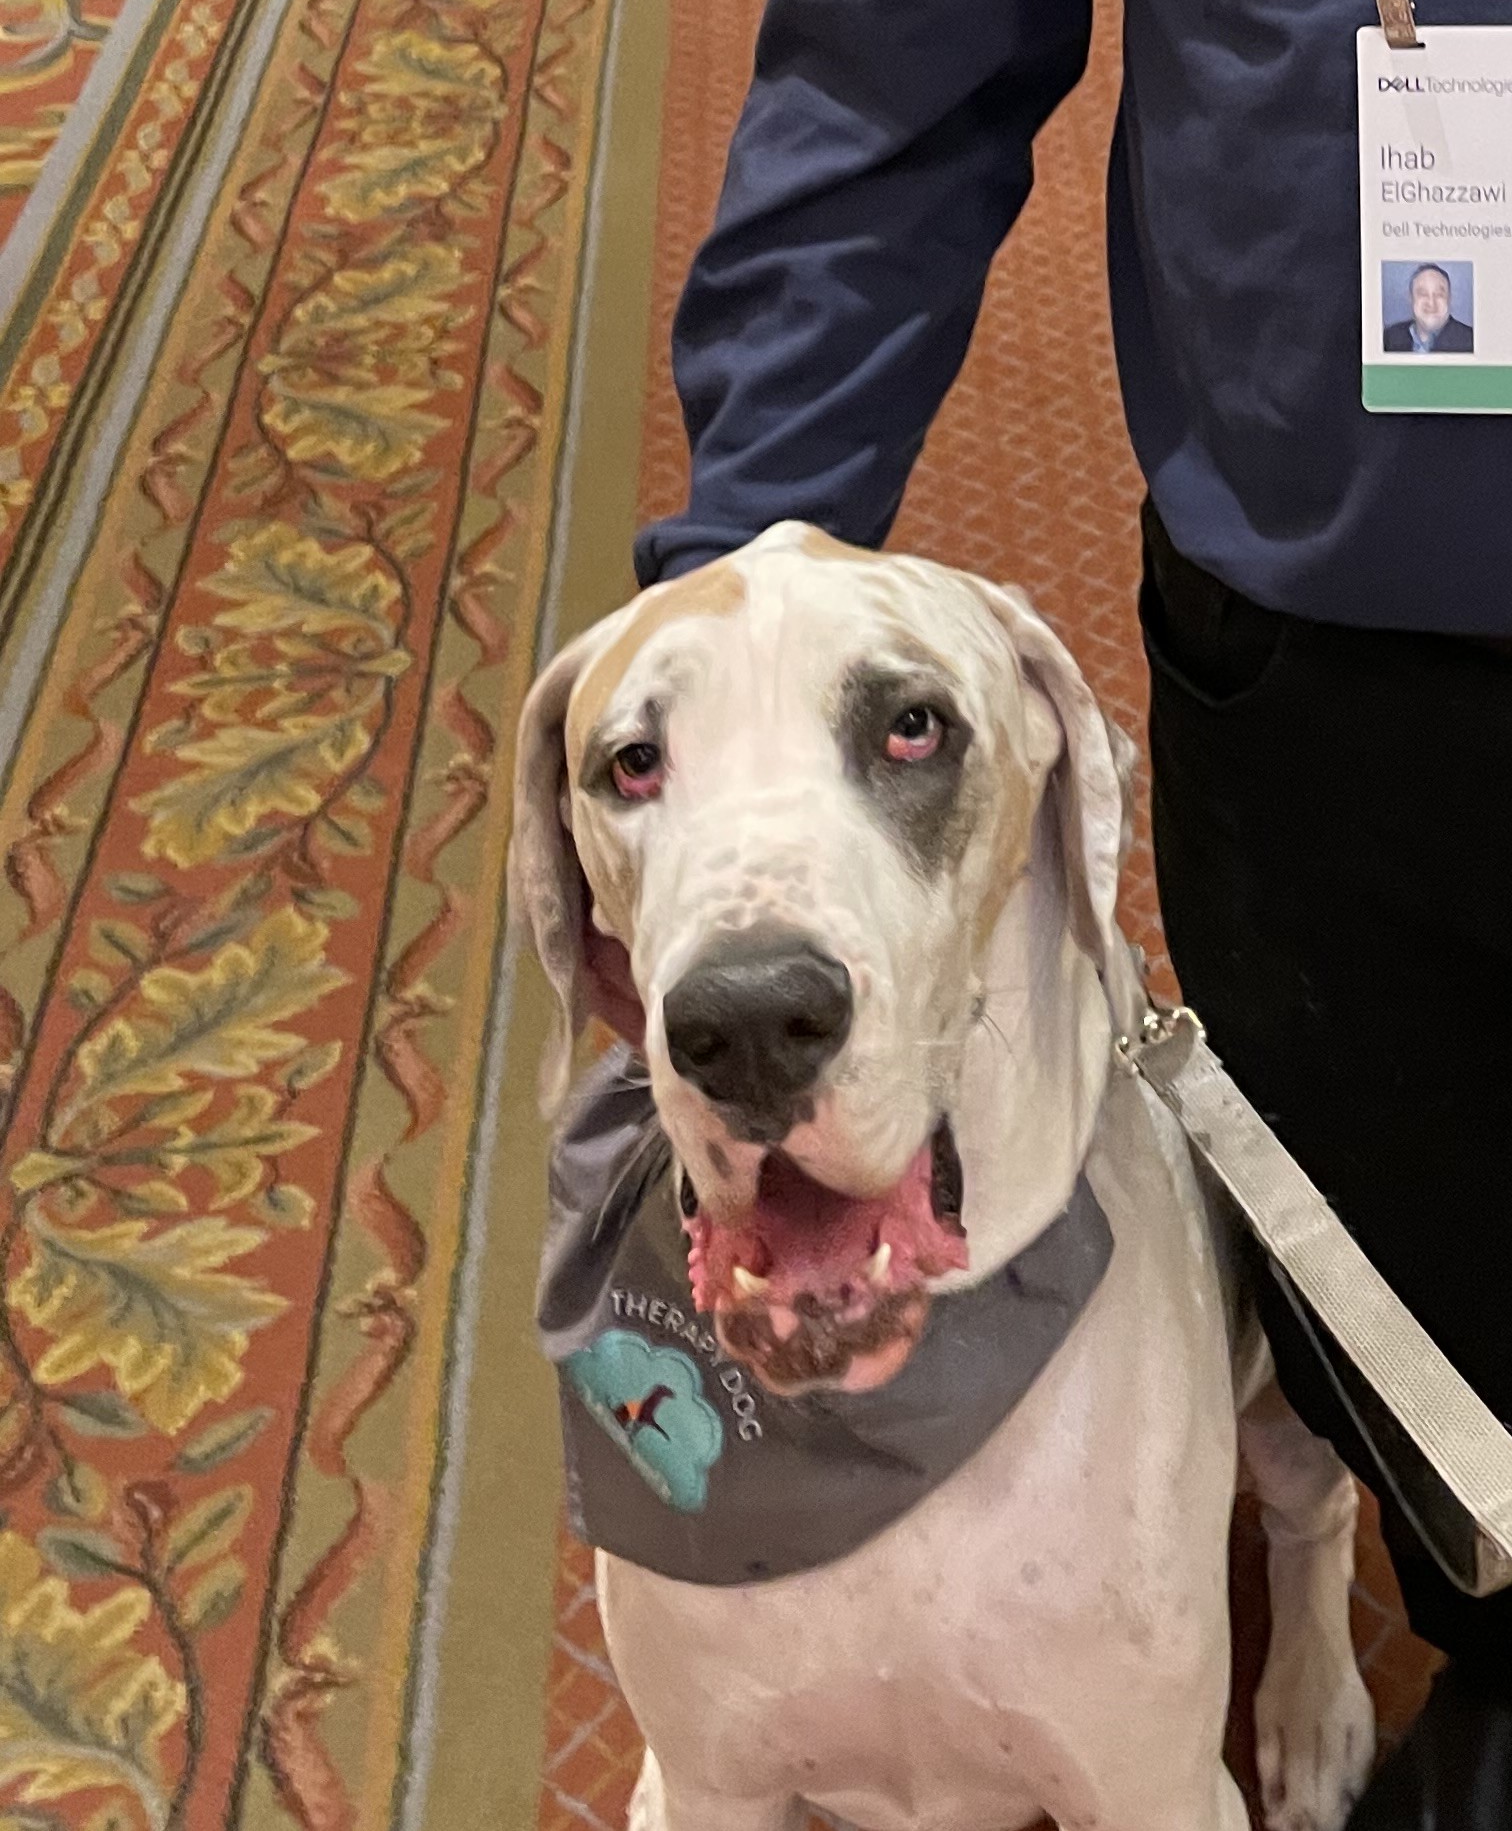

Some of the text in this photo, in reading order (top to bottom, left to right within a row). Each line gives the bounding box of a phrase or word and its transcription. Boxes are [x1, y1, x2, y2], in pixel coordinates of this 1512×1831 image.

[1380, 144, 1436, 170] Ihab
[1381, 179, 1507, 204] ElGhazzawi
[1382, 221, 1512, 241] Dell Technologies
